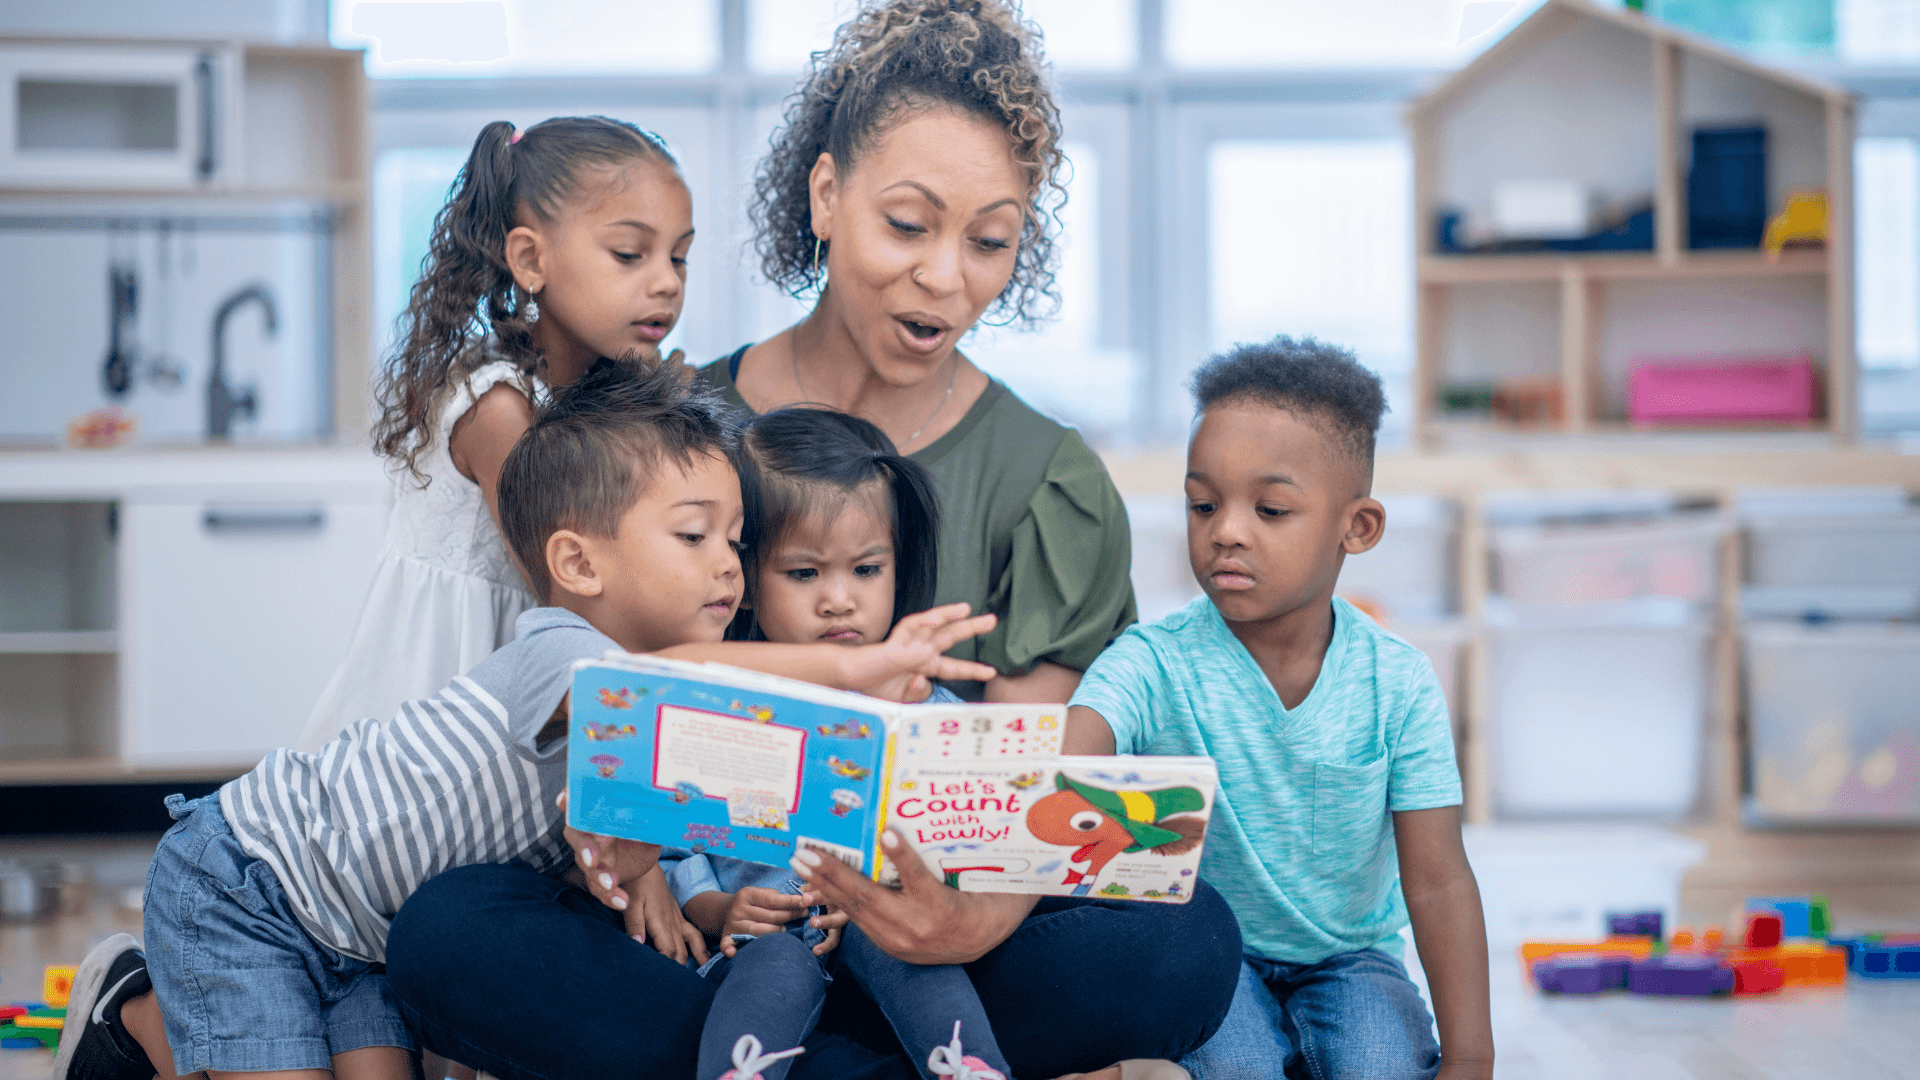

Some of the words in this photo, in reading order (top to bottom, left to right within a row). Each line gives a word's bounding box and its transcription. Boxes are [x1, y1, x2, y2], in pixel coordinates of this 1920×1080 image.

[1004, 717, 1027, 733] 4
[930, 779, 996, 796] Let's
[896, 793, 1021, 819] Count
[930, 814, 980, 827] with
[916, 825, 1010, 844] Lowly!
